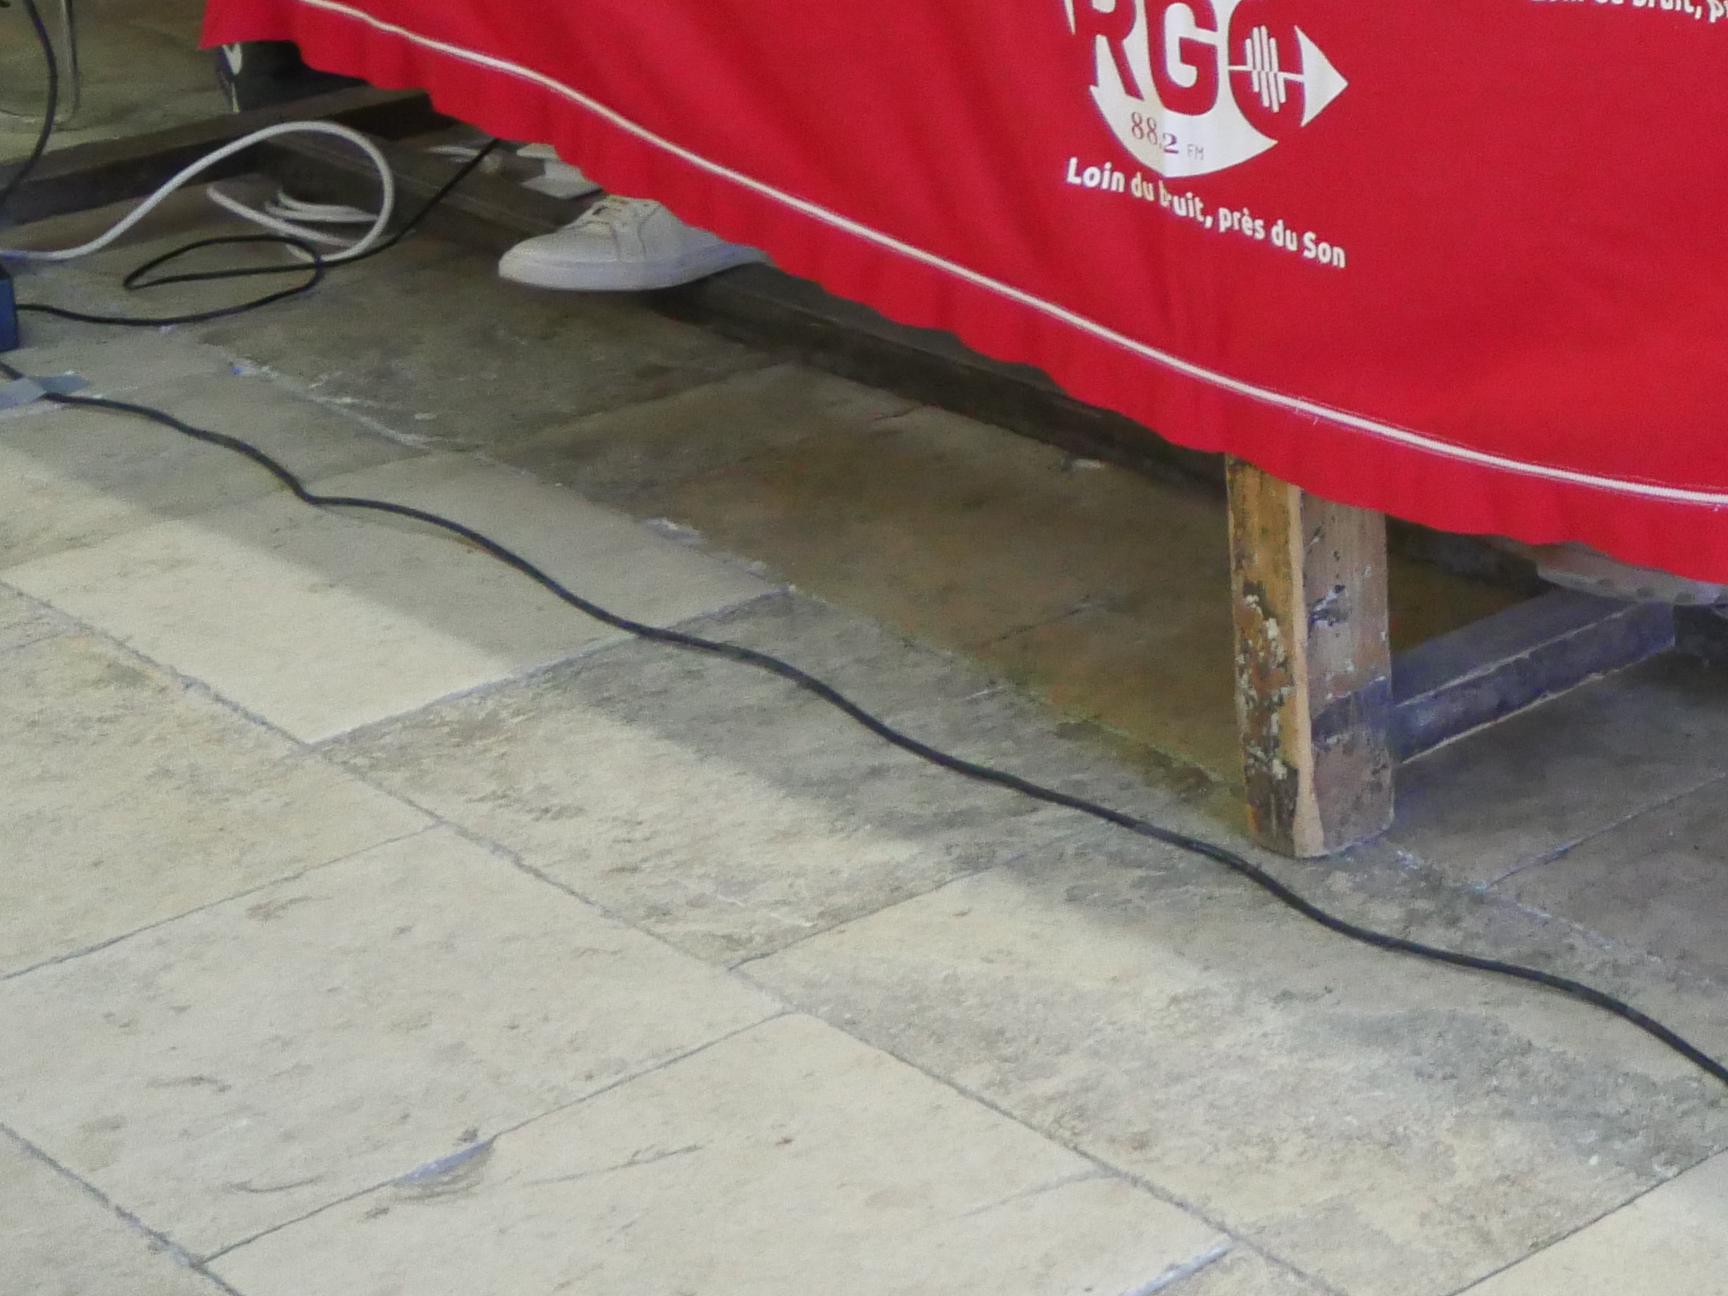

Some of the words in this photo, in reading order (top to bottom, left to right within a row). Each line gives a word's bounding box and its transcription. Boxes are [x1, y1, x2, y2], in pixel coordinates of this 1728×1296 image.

[1130, 111, 1181, 155] 88.2
[1186, 143, 1205, 162] FM
[1065, 156, 1126, 194] Loin
[1130, 171, 1155, 202] du
[1217, 205, 1265, 241] près
[1269, 218, 1299, 252] du
[1301, 230, 1347, 269] Son
